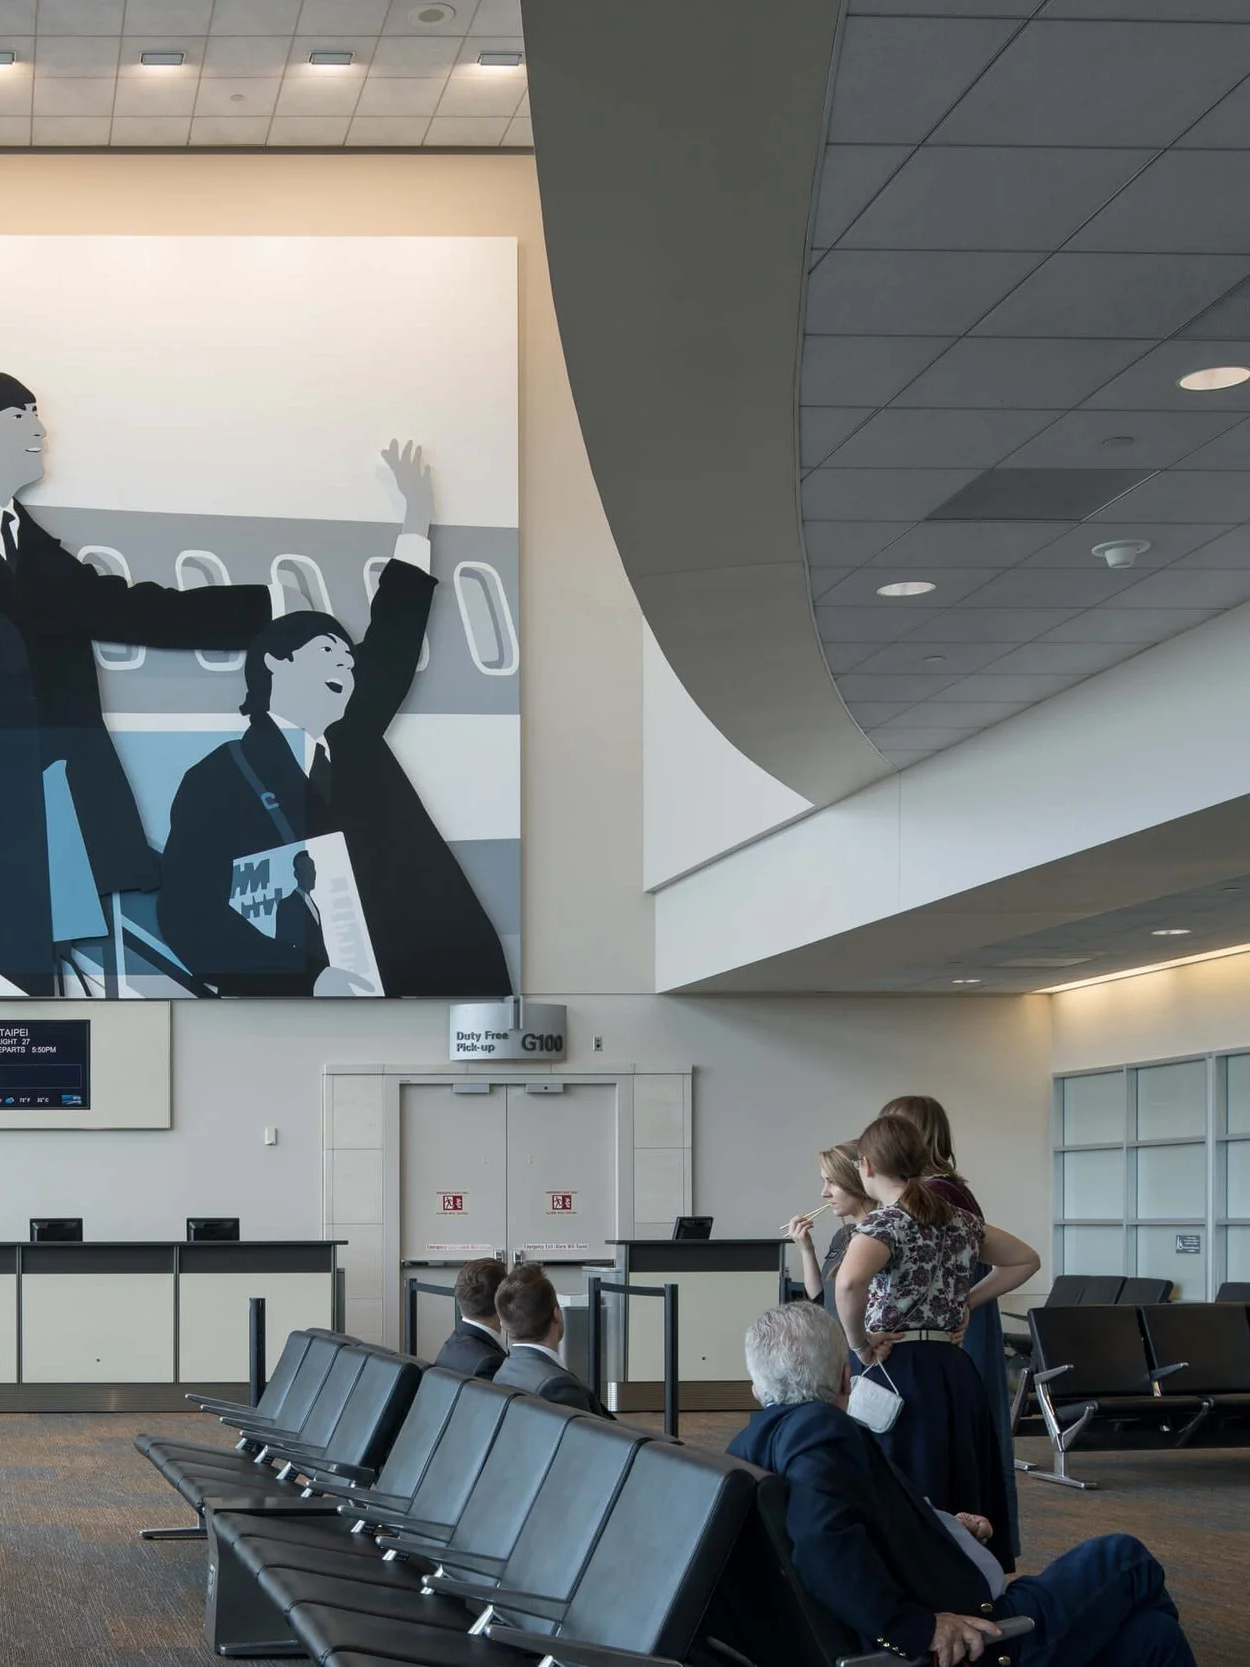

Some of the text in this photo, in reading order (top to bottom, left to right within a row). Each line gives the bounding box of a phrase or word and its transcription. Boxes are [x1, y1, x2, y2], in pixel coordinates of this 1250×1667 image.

[0, 1028, 29, 1037] TAIPEI
[456, 1030, 509, 1042] Duty Free
[456, 1042, 495, 1053] Pick-up
[521, 1033, 563, 1052] G100
